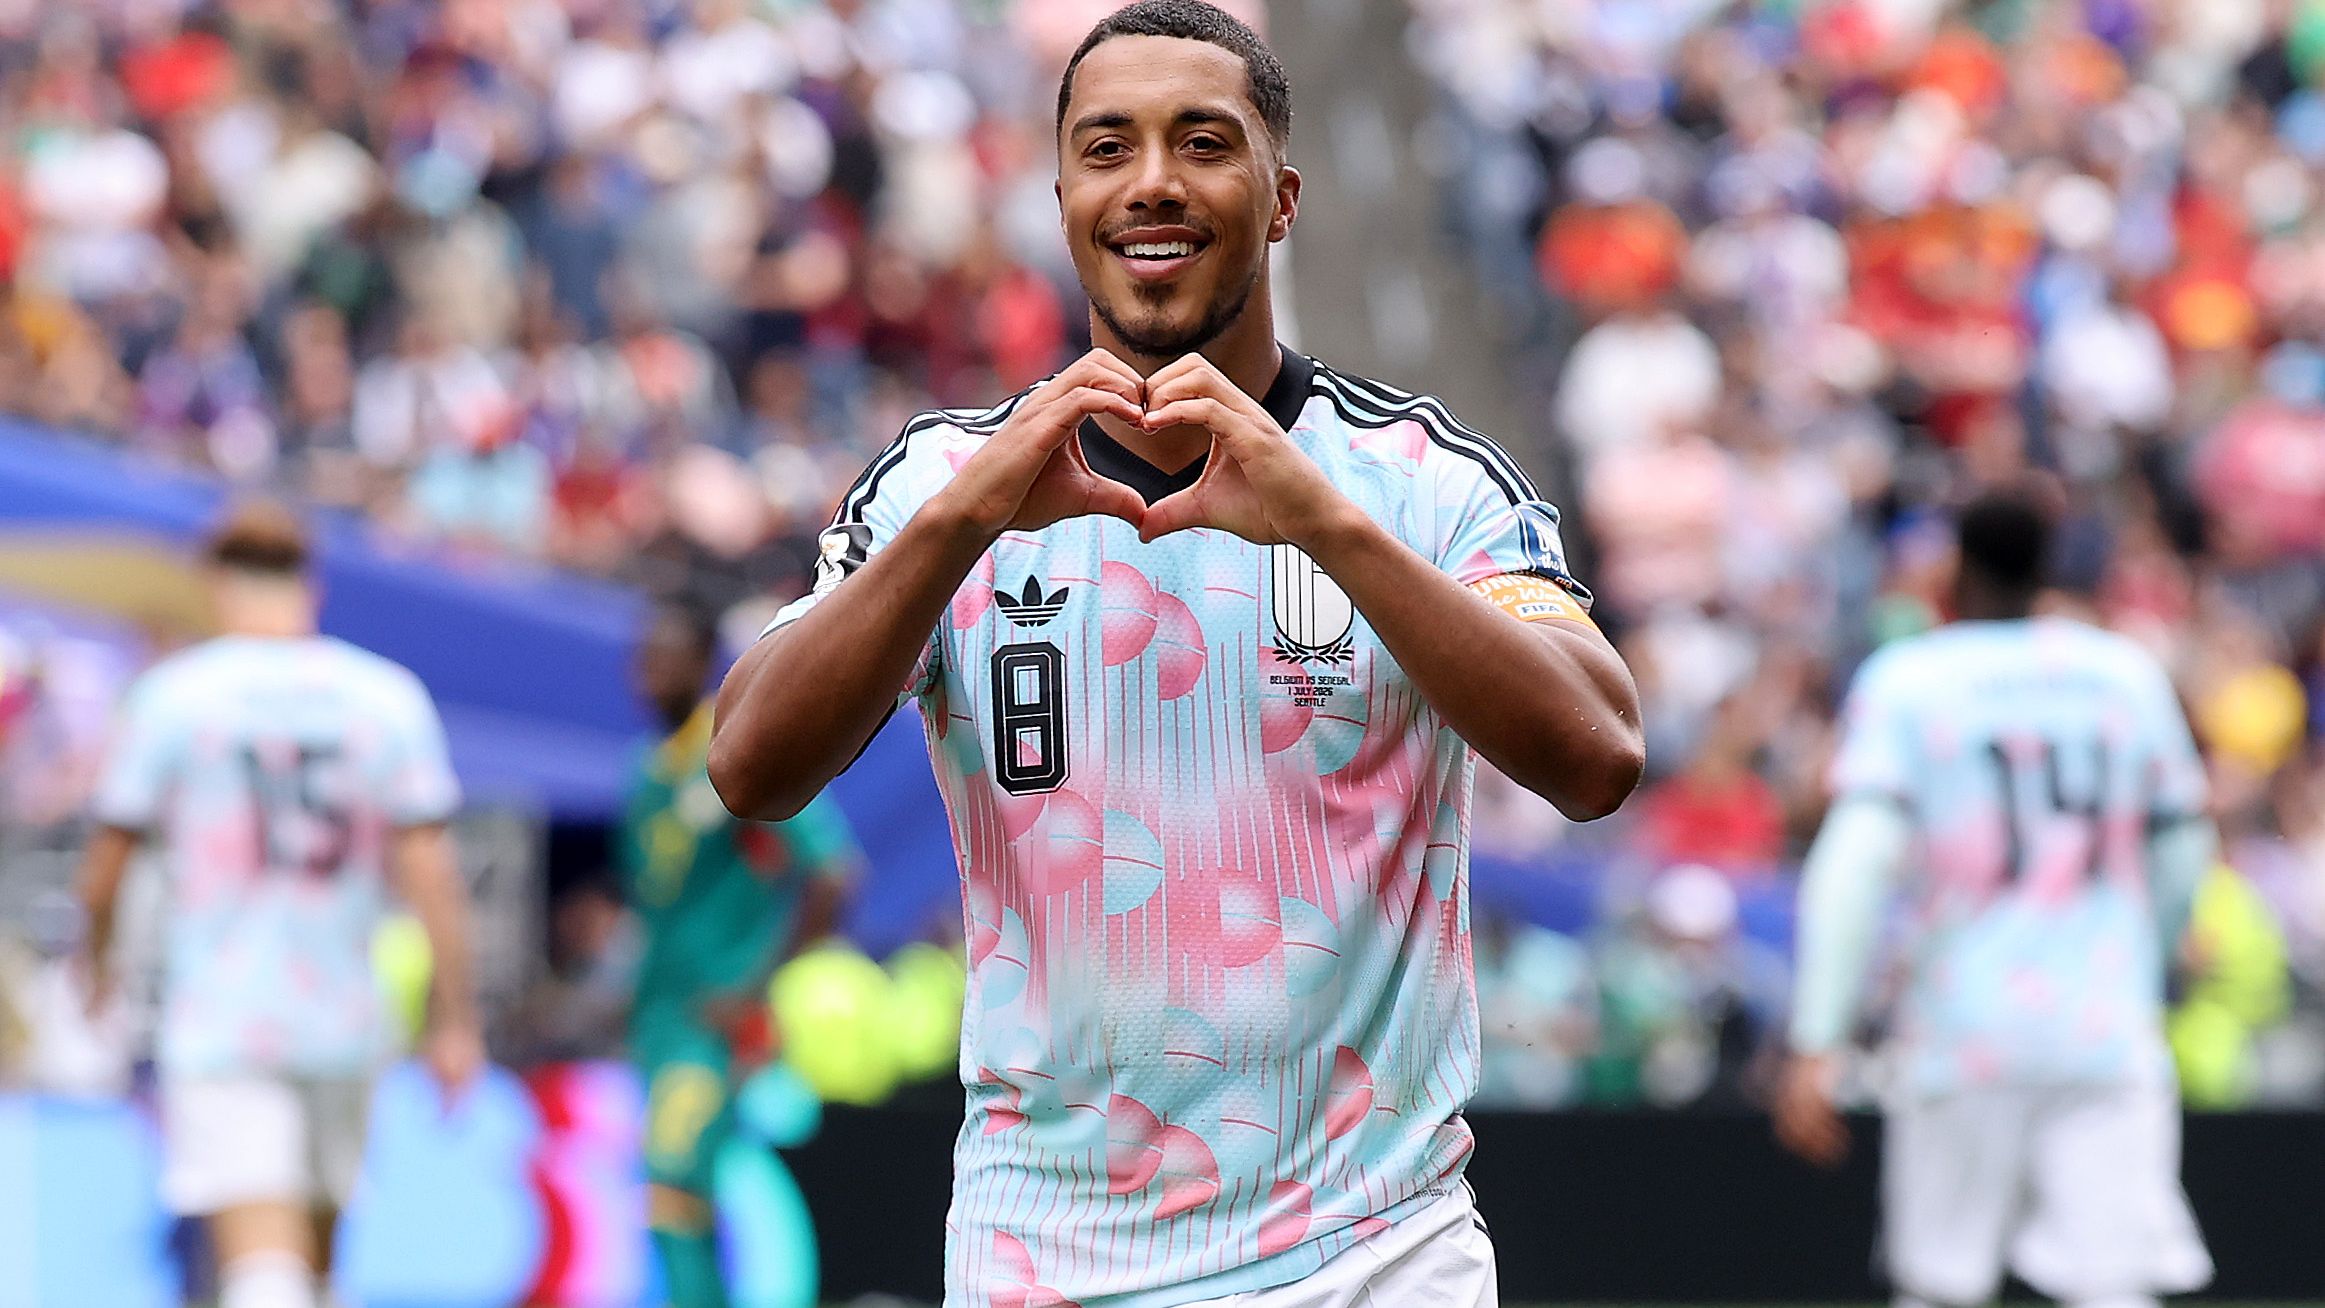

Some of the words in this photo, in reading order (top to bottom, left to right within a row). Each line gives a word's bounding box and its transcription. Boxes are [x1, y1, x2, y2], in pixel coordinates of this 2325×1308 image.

[1521, 603, 1561, 614] FIFA
[1269, 675, 1304, 685] BELGIUM
[1306, 675, 1316, 685] VS
[1317, 675, 1351, 686] SENEGAL
[1287, 686, 1292, 696] 1
[1293, 686, 1312, 696] JULY
[1312, 686, 1334, 697] 2026
[1294, 697, 1326, 707] SEATTLE
[991, 641, 1071, 796] 8
[238, 737, 355, 878] 15
[1983, 738, 2112, 884] 14
